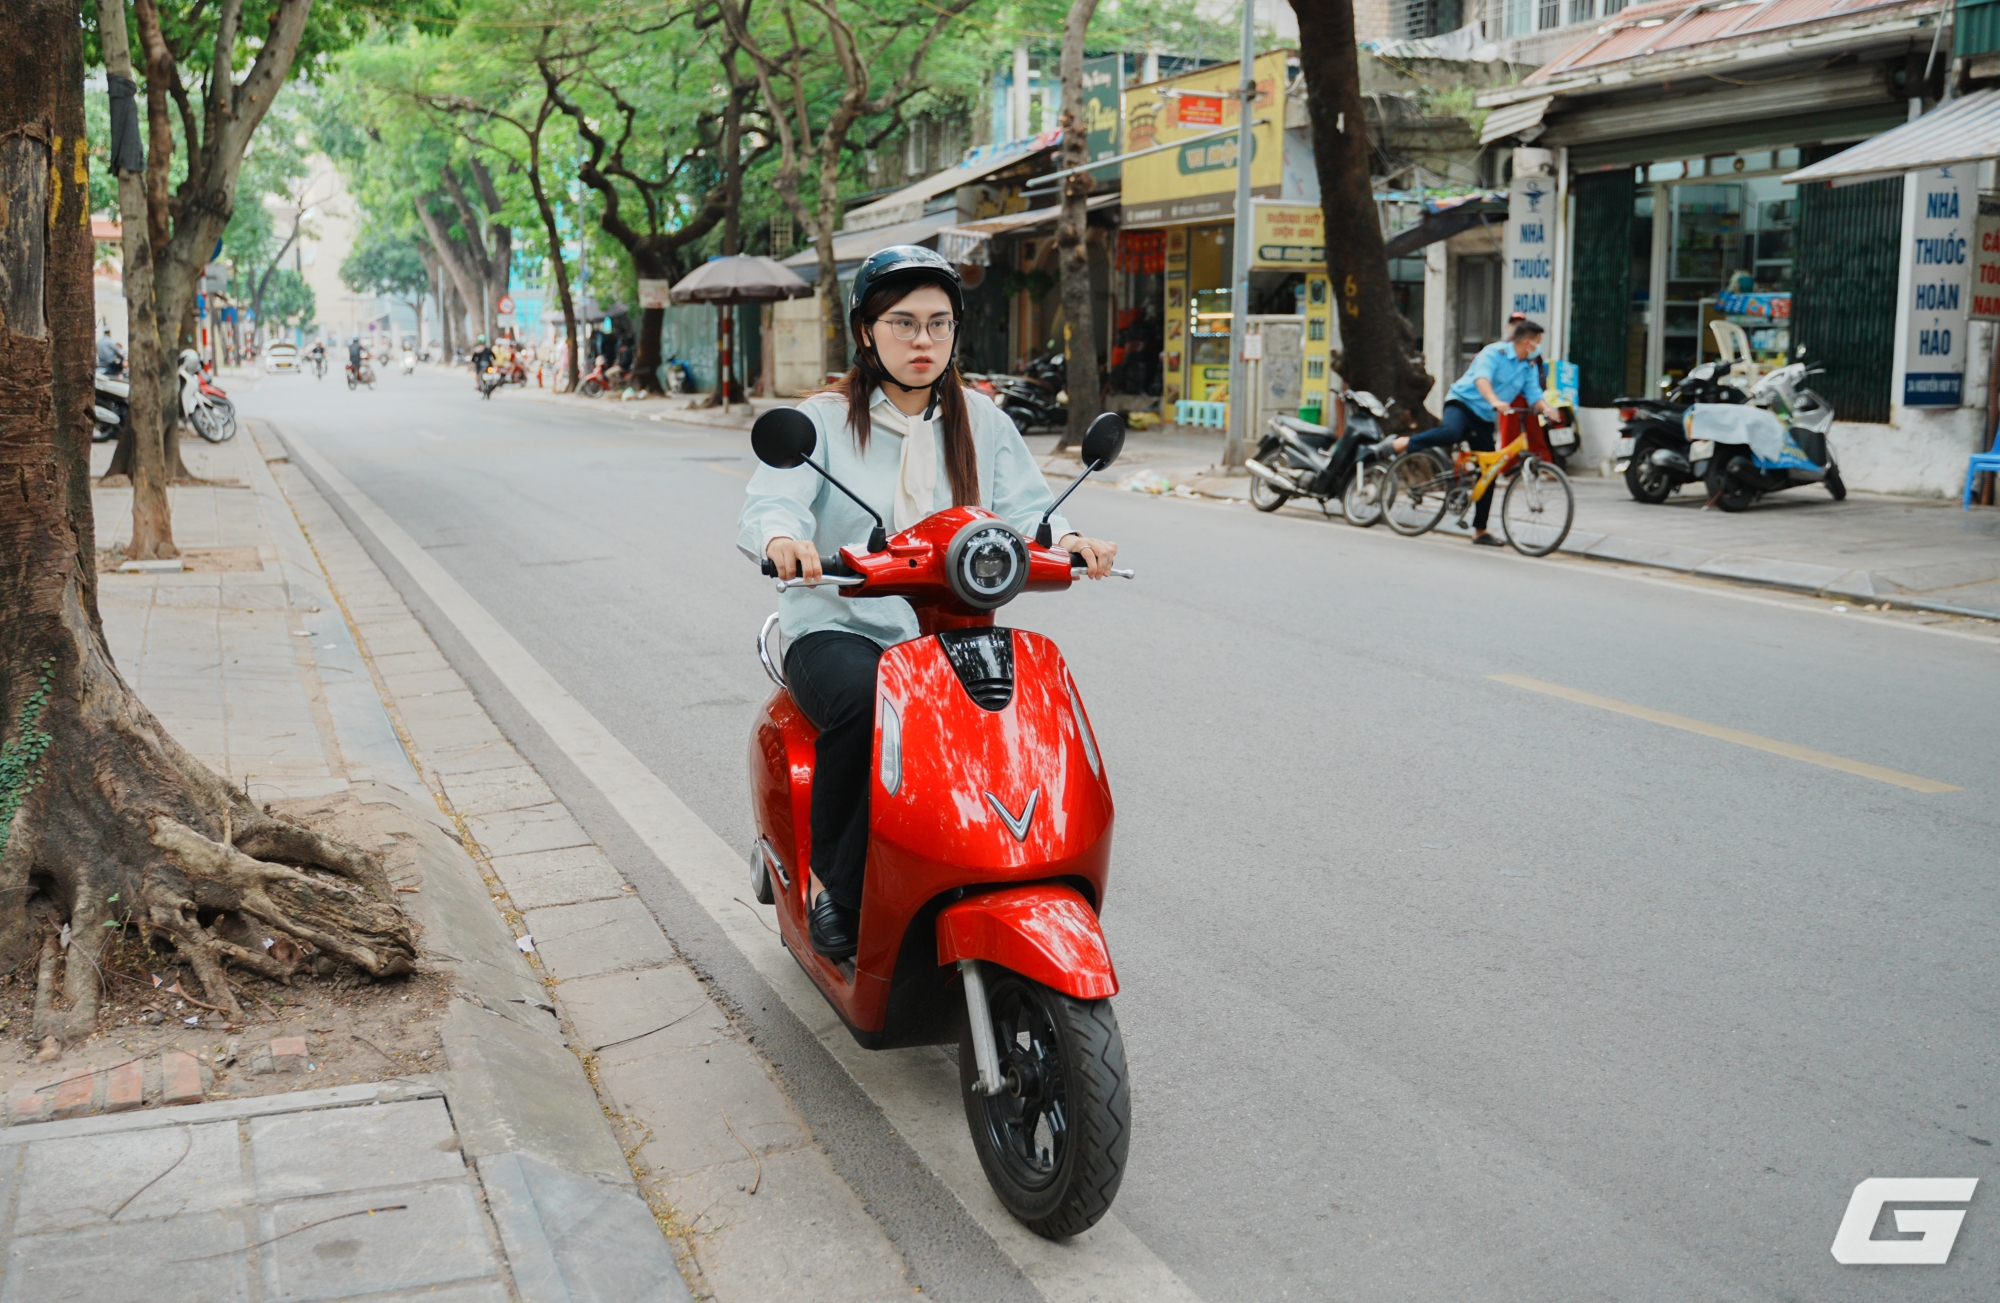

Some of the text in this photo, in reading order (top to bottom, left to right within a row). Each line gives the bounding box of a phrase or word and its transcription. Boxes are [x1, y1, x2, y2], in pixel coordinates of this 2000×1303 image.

[1207, 138, 1239, 167] MỘ
[1926, 186, 1959, 219] NHÀ
[1520, 219, 1544, 244] NHÀ
[1915, 227, 1967, 265] THUỐC
[1512, 250, 1551, 279] THUỐC
[1513, 288, 1547, 313] HOÀN
[1915, 278, 1959, 311] HOÀN
[1919, 318, 1951, 356] HẢO
[955, 640, 1005, 650] VINFAST
